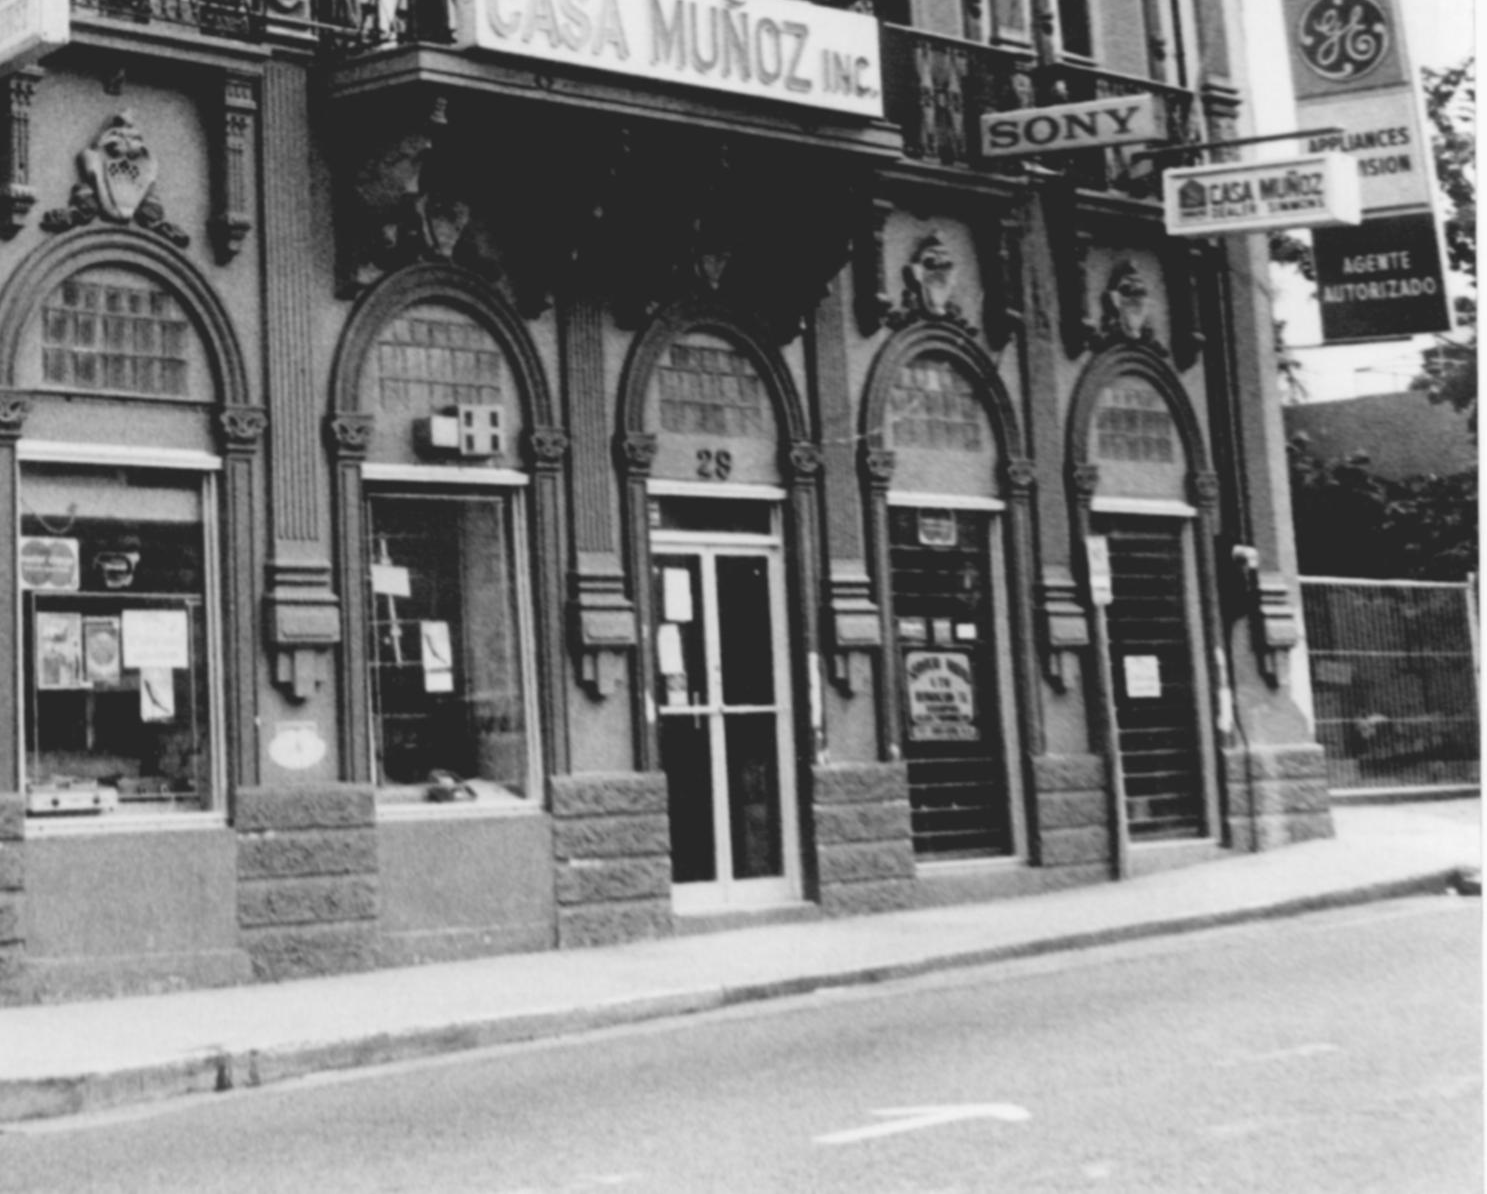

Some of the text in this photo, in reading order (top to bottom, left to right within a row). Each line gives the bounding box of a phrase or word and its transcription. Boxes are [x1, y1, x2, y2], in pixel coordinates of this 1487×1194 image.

[820, 48, 882, 100] INC.
[988, 105, 1141, 149] SONY
[1308, 126, 1410, 154] APPLIANCES
[1210, 169, 1324, 206] CASA MUÑOZ
[1342, 251, 1410, 275] AGENTE
[1323, 277, 1436, 303] AUTORIZADO
[696, 448, 732, 481] 28
